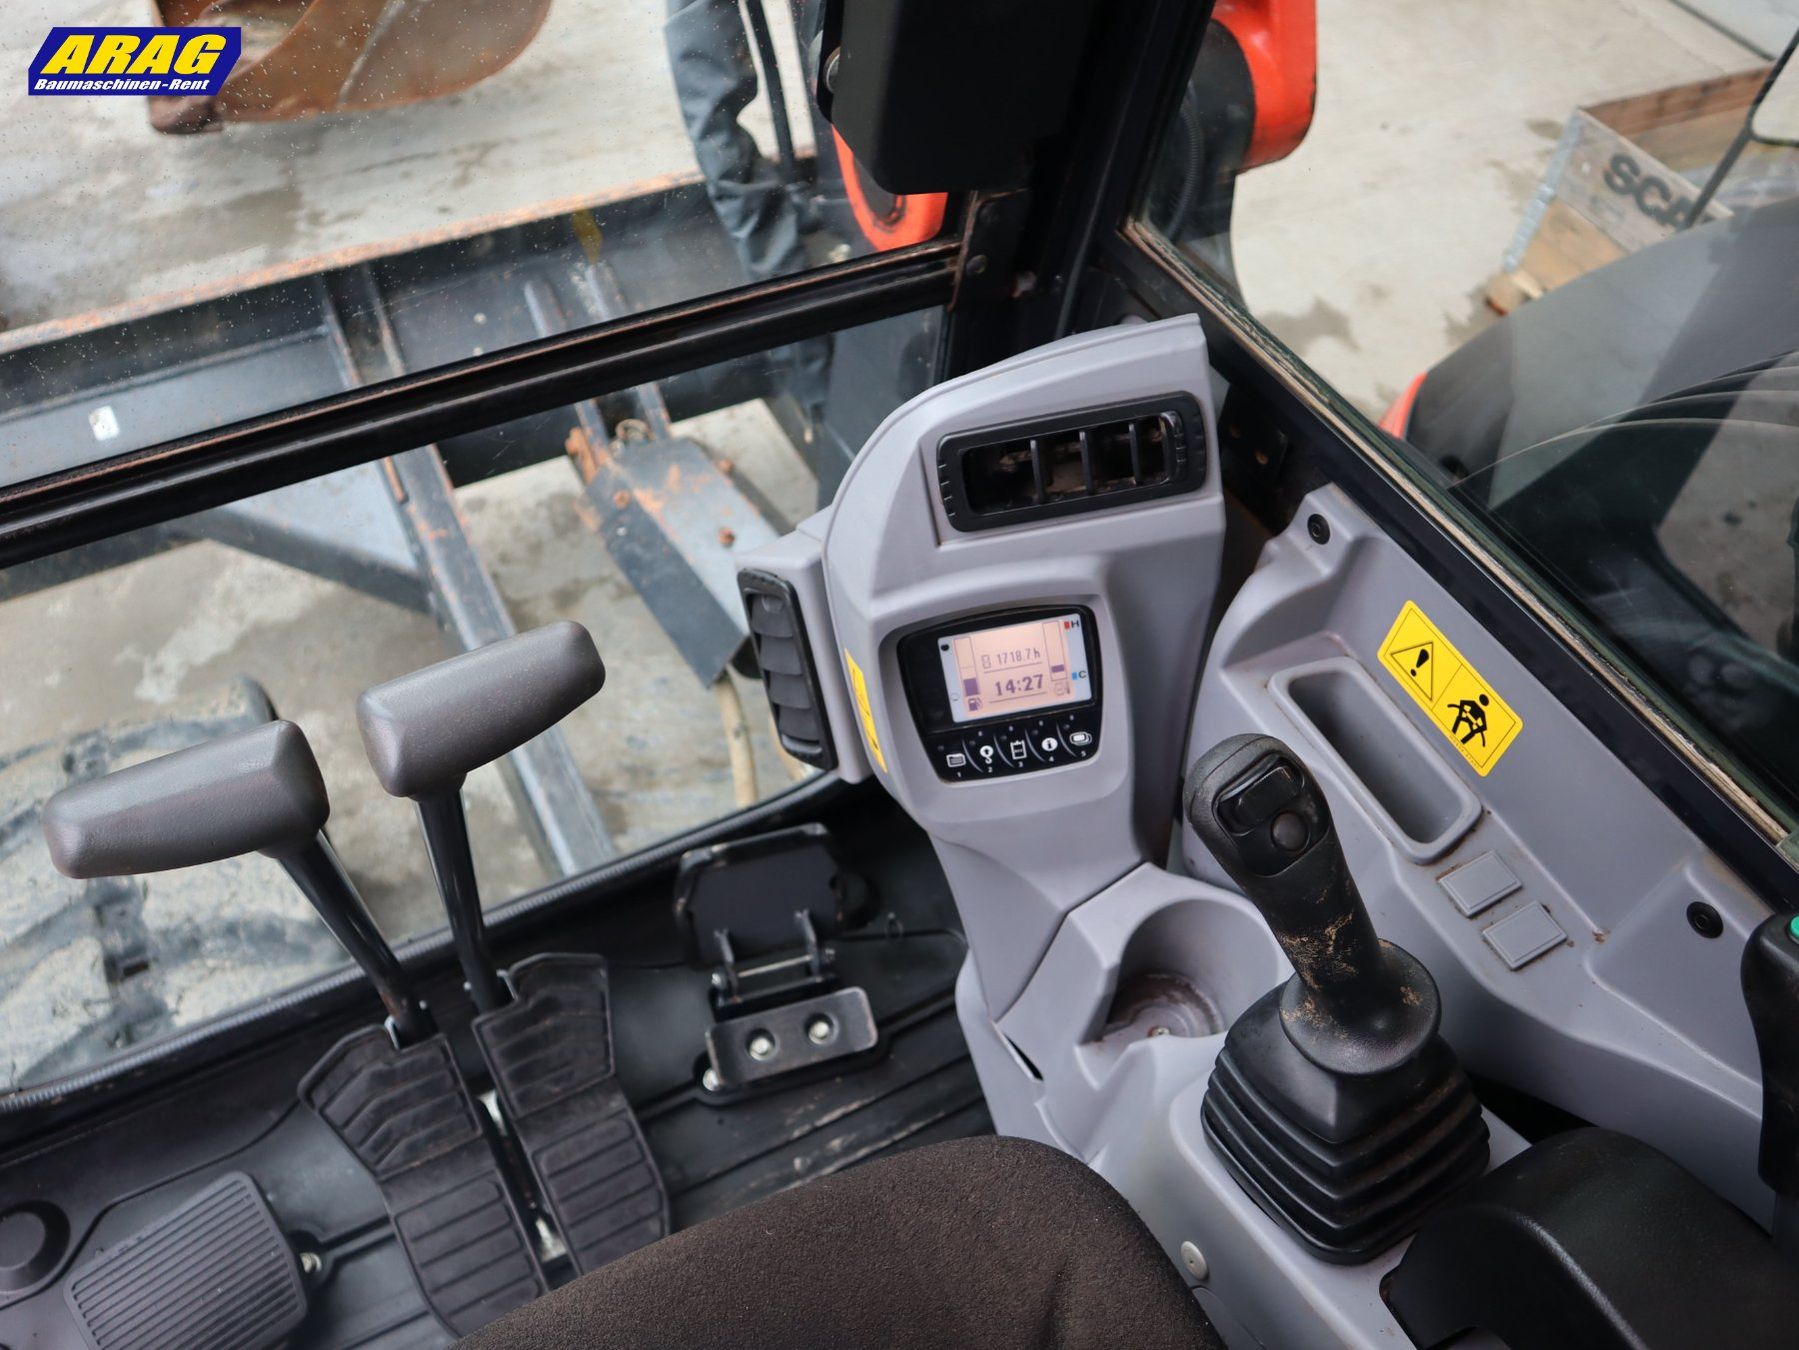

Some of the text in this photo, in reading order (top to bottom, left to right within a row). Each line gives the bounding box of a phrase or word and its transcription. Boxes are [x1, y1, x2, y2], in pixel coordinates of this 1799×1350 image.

[1071, 620, 1080, 628] H
[1078, 670, 1087, 679] C
[995, 674, 1043, 696] 14:27
